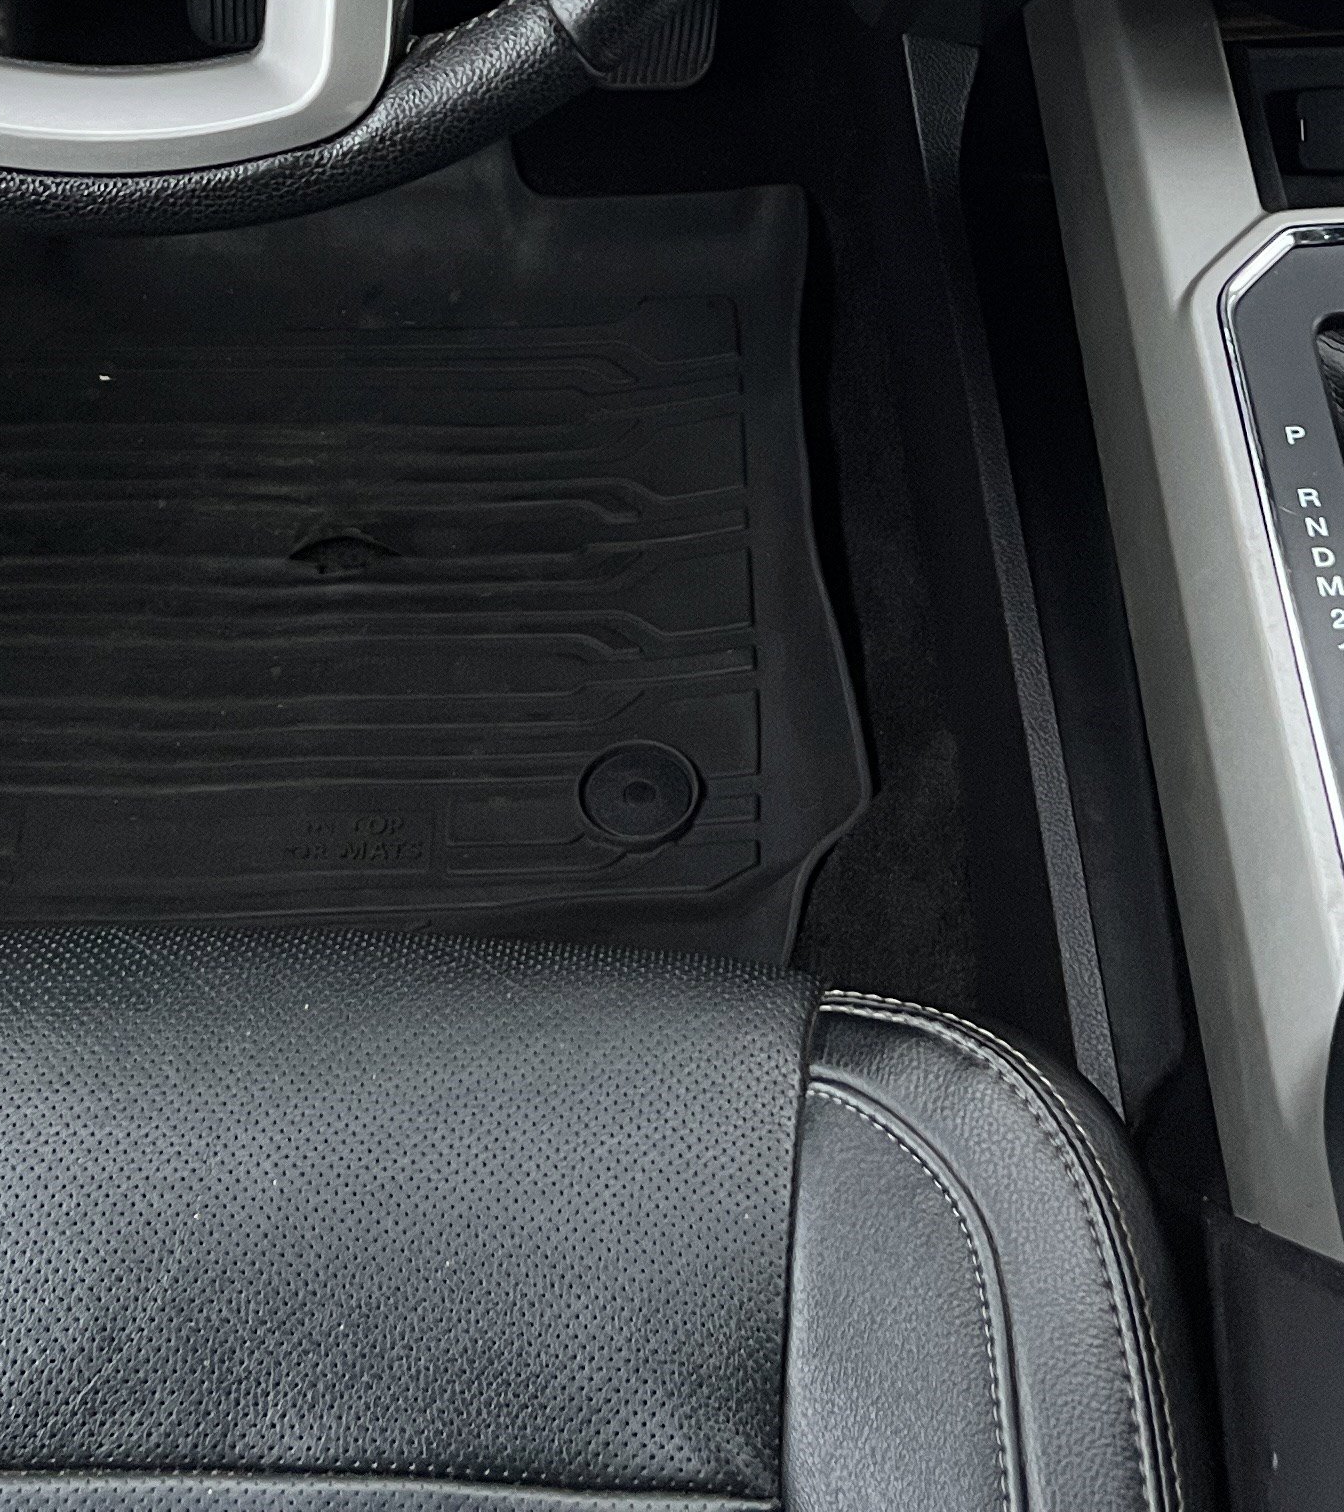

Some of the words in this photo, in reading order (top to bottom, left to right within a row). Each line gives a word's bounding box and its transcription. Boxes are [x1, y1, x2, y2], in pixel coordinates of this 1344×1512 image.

[1284, 425, 1306, 445] P
[1296, 487, 1322, 508] R
[1304, 516, 1329, 539] N
[1311, 546, 1336, 569] D
